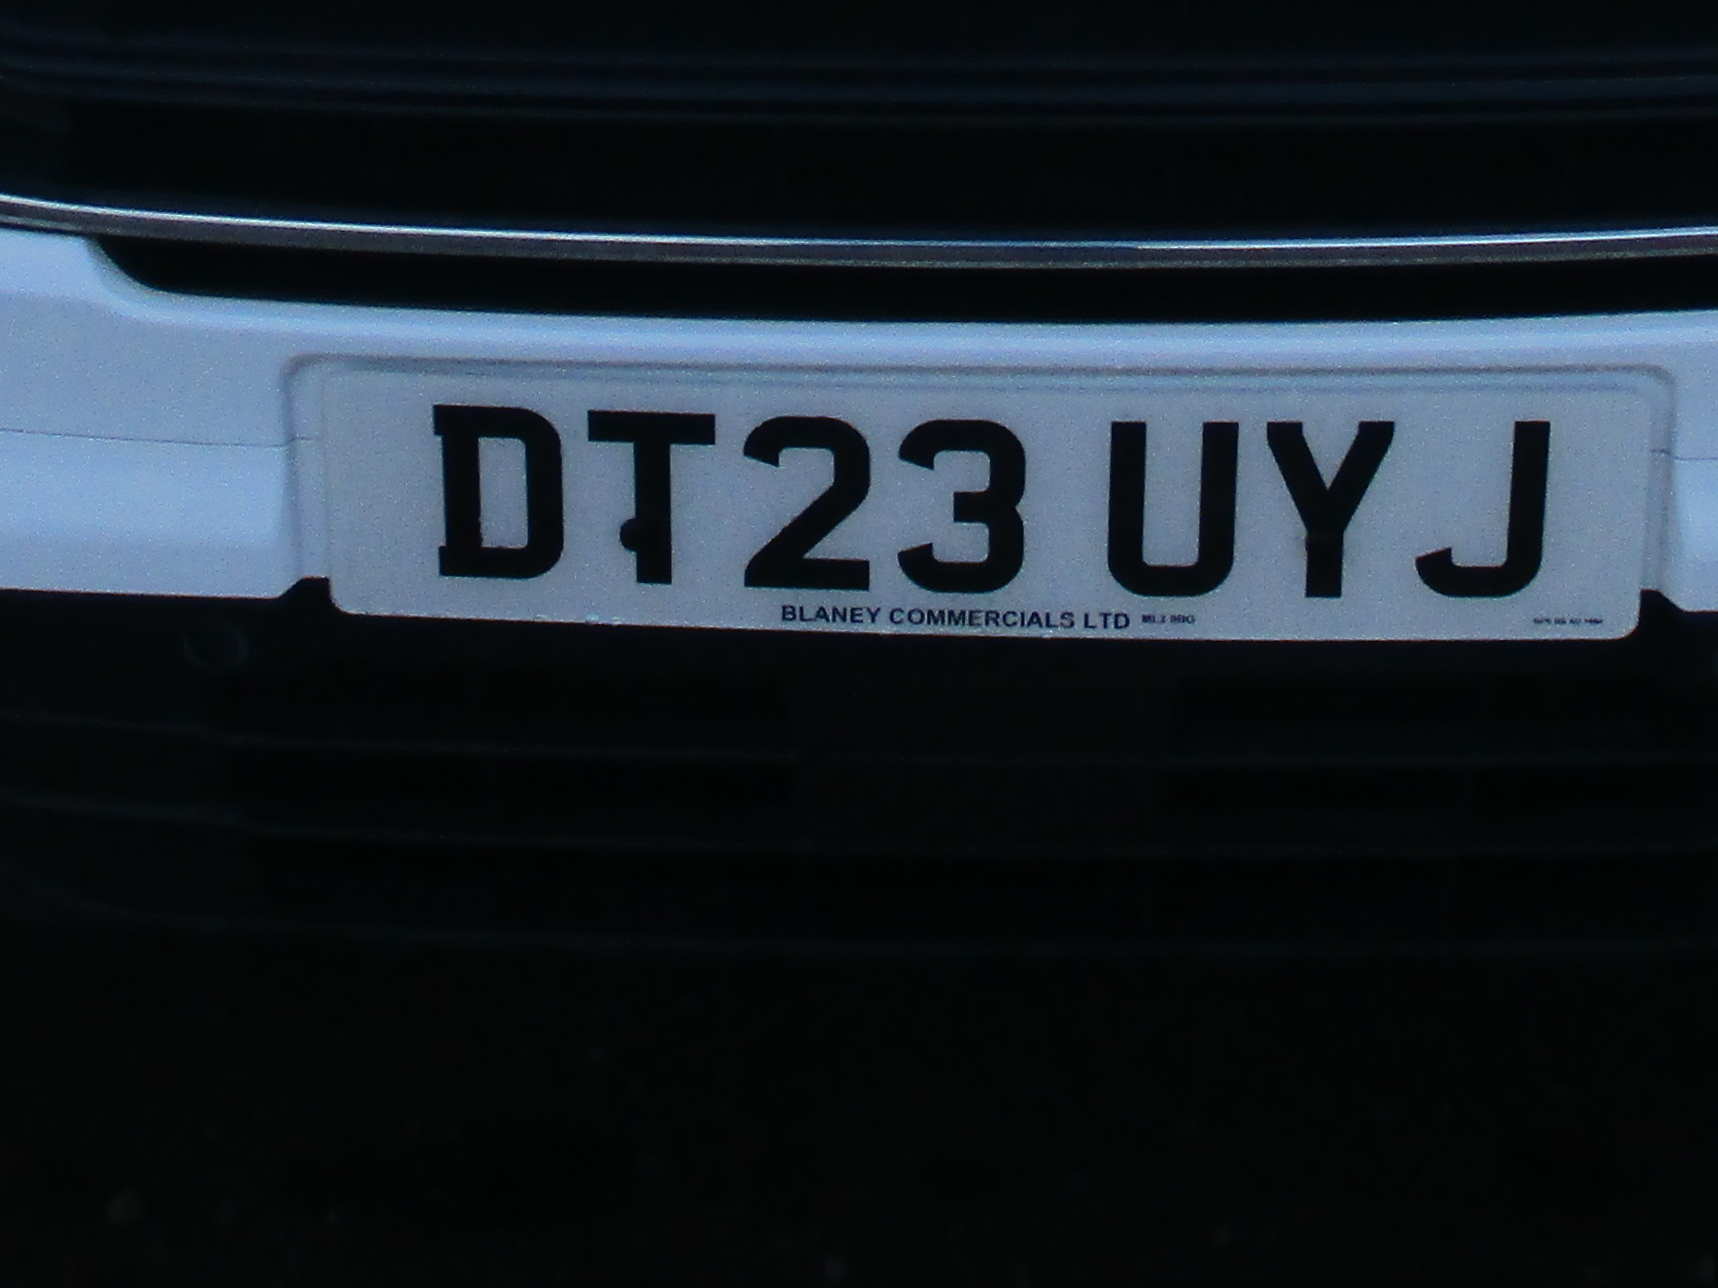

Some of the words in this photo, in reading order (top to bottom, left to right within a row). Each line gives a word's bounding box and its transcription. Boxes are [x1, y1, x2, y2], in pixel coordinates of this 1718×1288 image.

[431, 402, 1028, 596] DT23
[1106, 419, 1552, 600] UYJ
[781, 605, 880, 625] BLANEY
[889, 607, 1074, 629] COMMERCIALS
[1083, 612, 1131, 630] LTD
